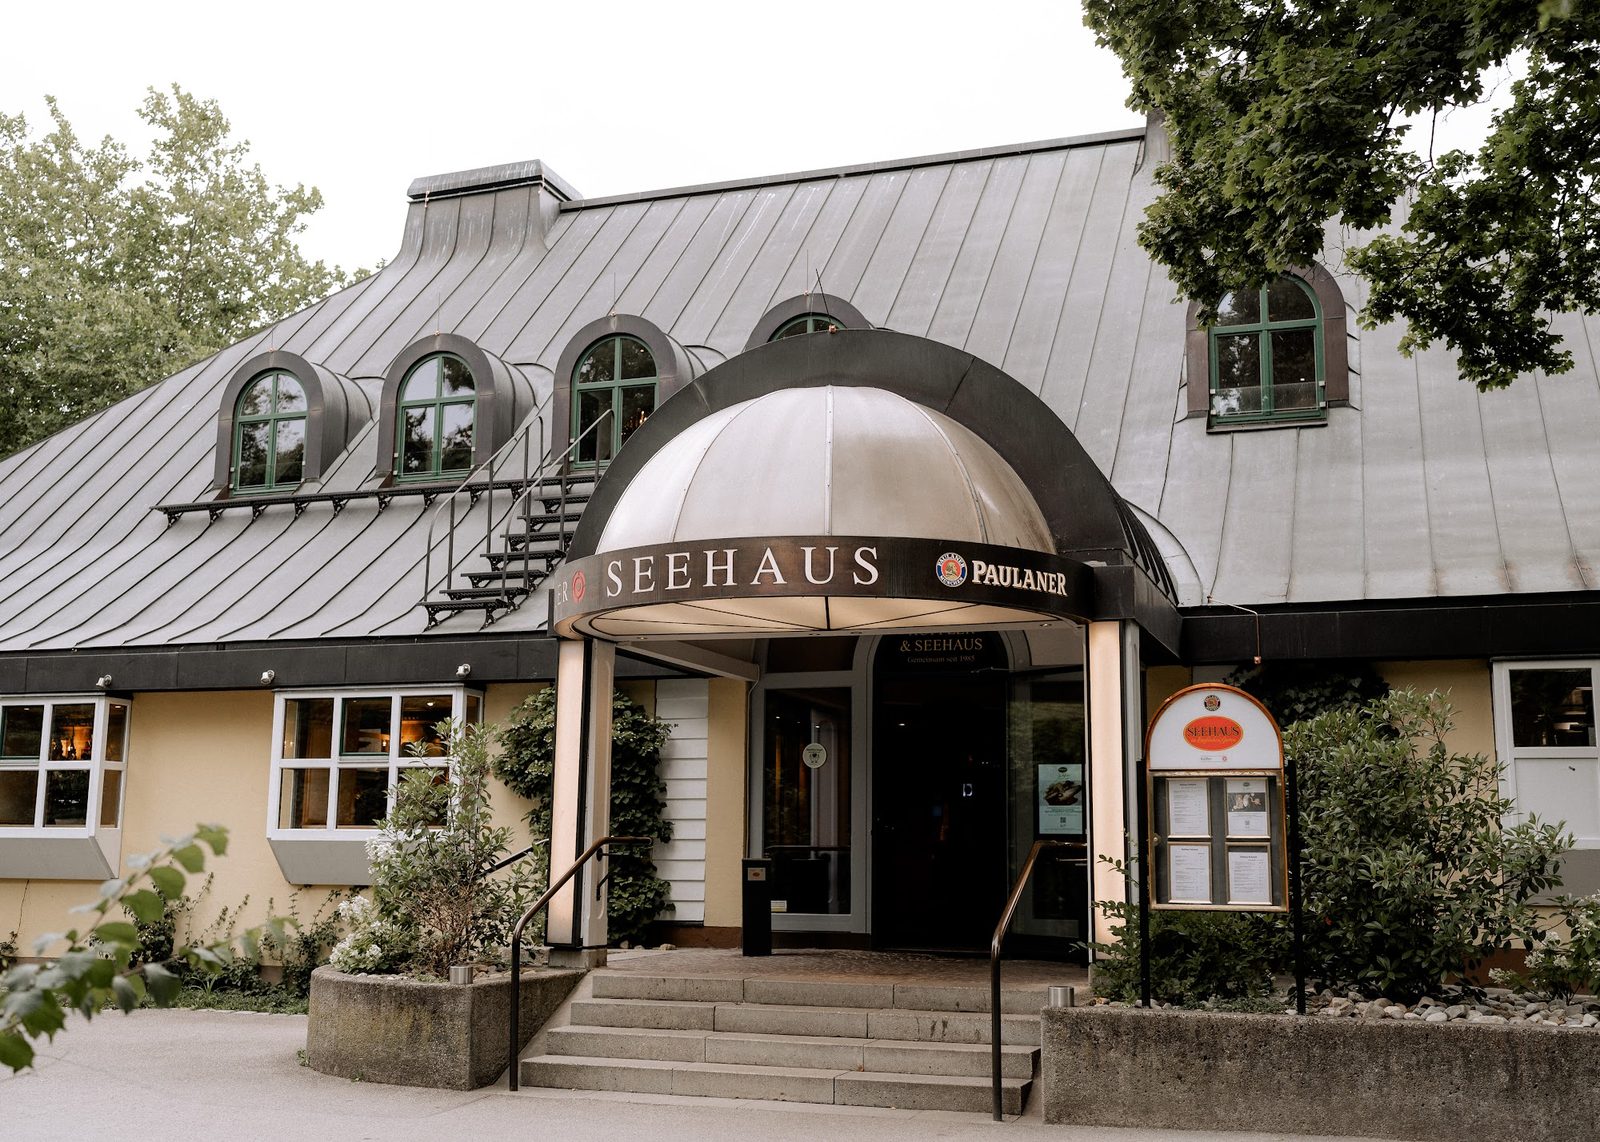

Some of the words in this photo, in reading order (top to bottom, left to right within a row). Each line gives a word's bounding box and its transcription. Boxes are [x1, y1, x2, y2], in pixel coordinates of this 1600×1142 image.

[606, 546, 879, 597] SEEHAUS
[971, 560, 1068, 596] PAULANER
[900, 639, 911, 652] &
[914, 637, 983, 652] SEEHAUS
[1187, 726, 1240, 737] SEEHAUS
